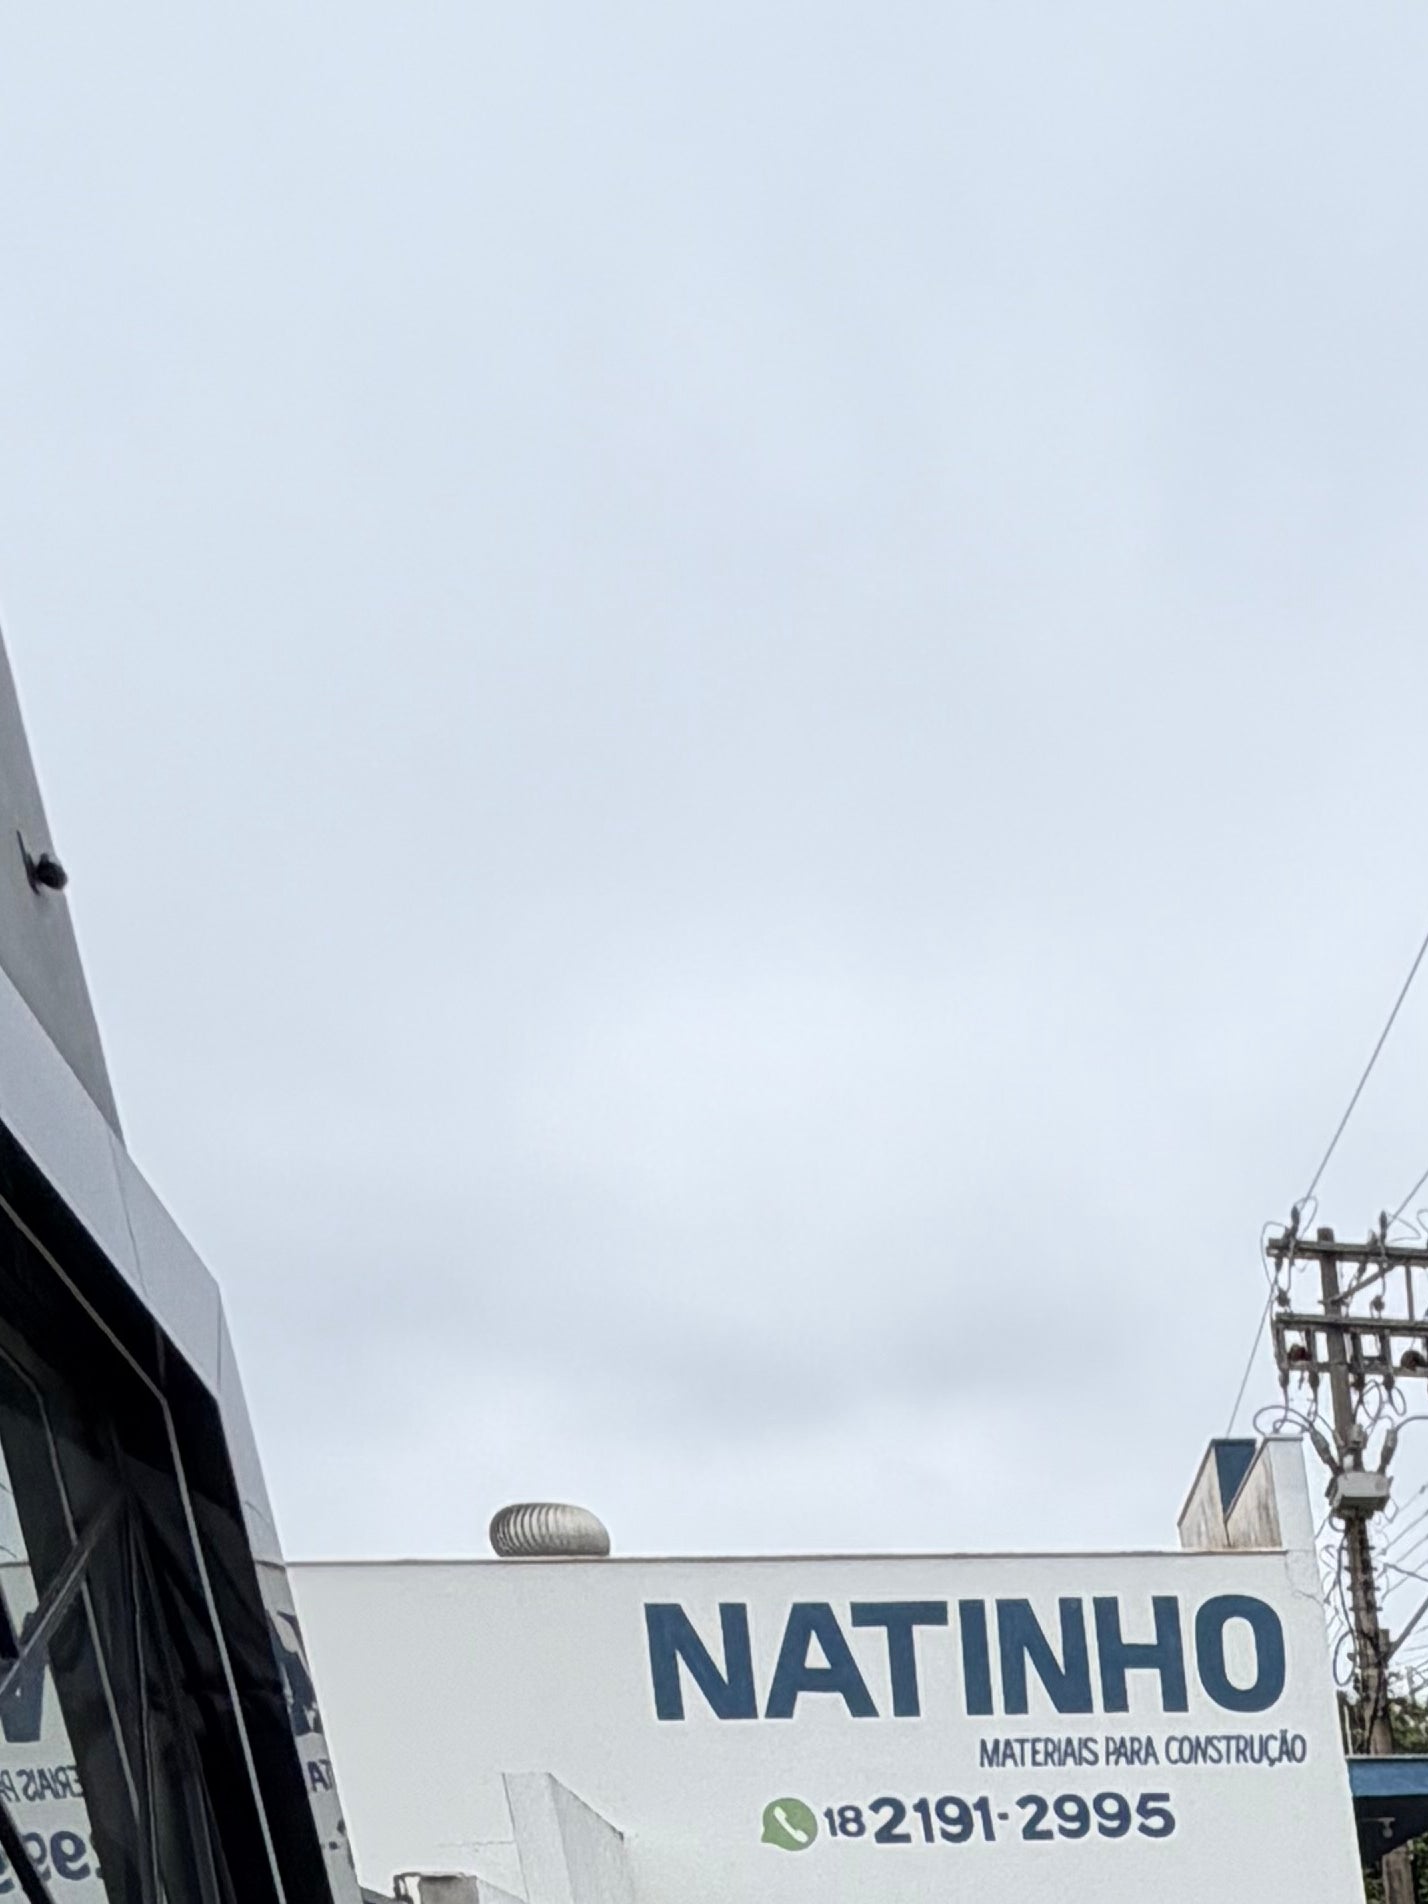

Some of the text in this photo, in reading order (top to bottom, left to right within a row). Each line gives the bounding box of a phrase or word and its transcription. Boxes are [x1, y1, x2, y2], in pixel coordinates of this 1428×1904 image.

[643, 1593, 1286, 1720] NATINHO
[979, 1729, 1307, 1768] MATERIAIS PARA CONSTRUÇÃO
[823, 1791, 1176, 1844] 18 2191-2995
